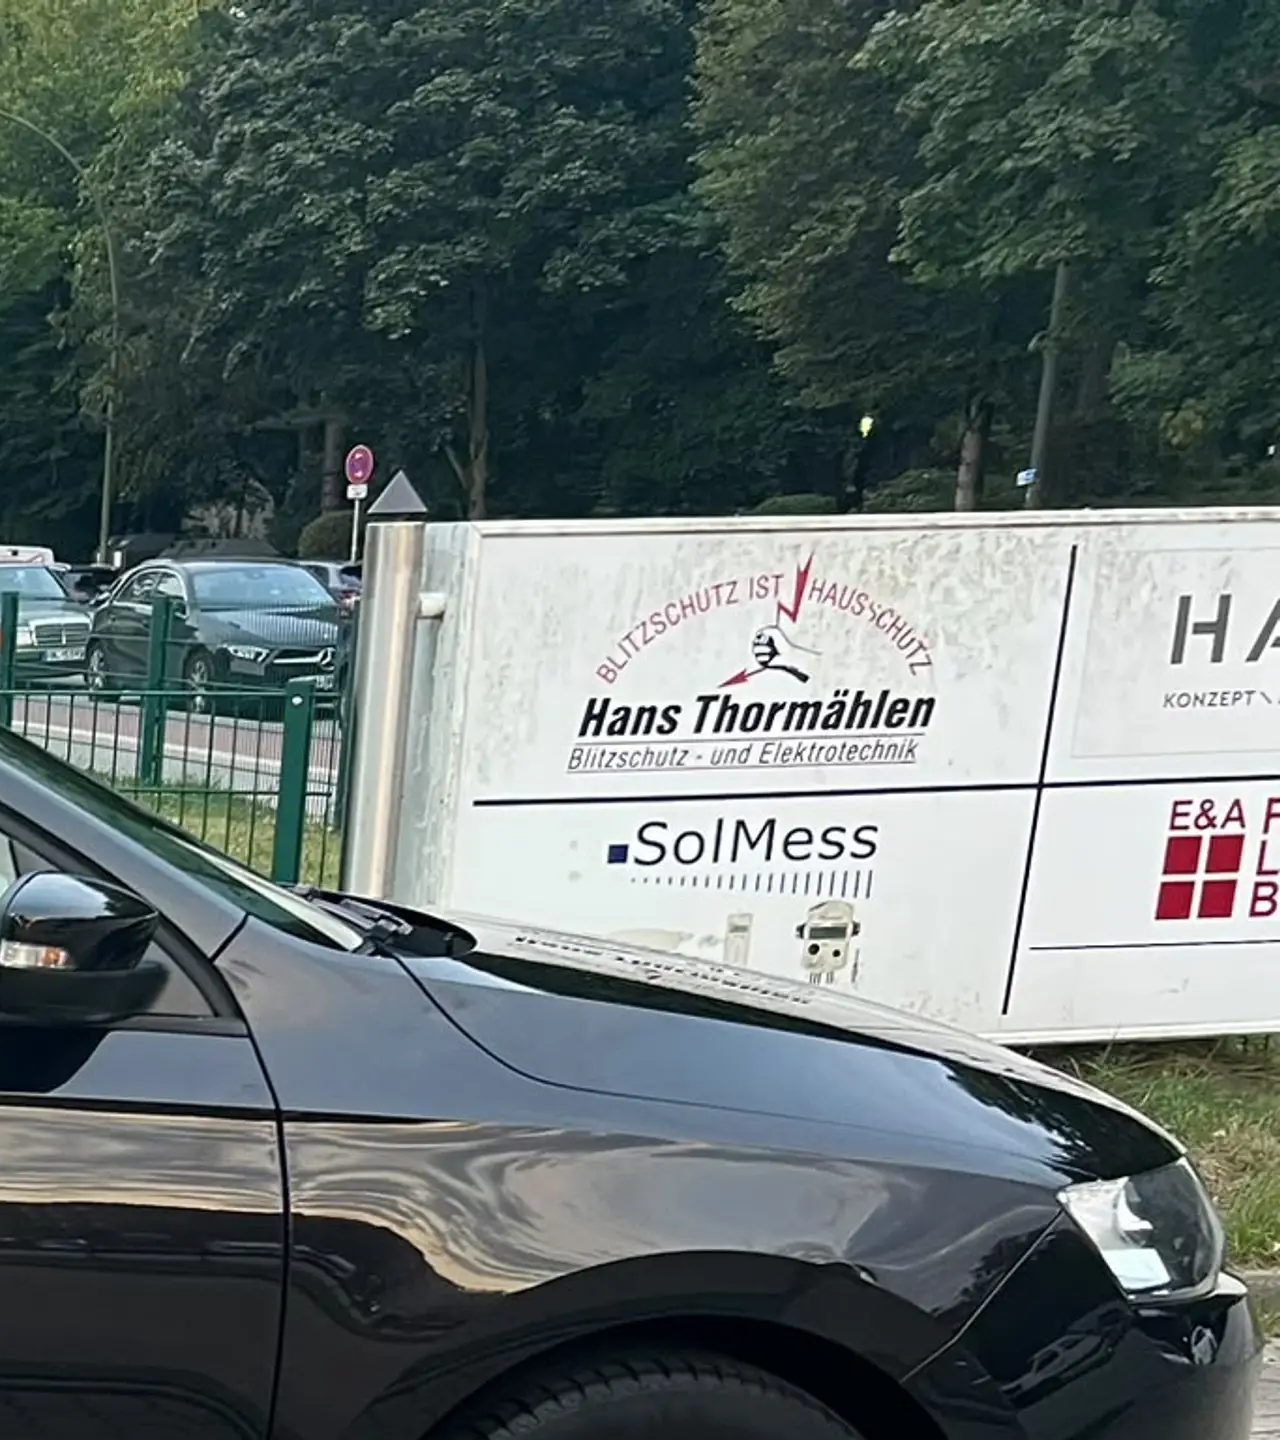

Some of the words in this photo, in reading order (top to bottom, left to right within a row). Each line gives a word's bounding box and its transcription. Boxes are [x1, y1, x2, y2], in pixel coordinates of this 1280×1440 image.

[596, 580, 740, 684] BLITZSCHUTZ
[748, 573, 786, 600] IST
[578, 697, 682, 738] Hans
[692, 689, 937, 734] Thormählen
[567, 744, 691, 771] Blitzschutz
[710, 743, 751, 765] und
[758, 737, 920, 765] Elektrotechnik
[1169, 799, 1246, 831] E&A
[633, 817, 880, 866] SolMess
